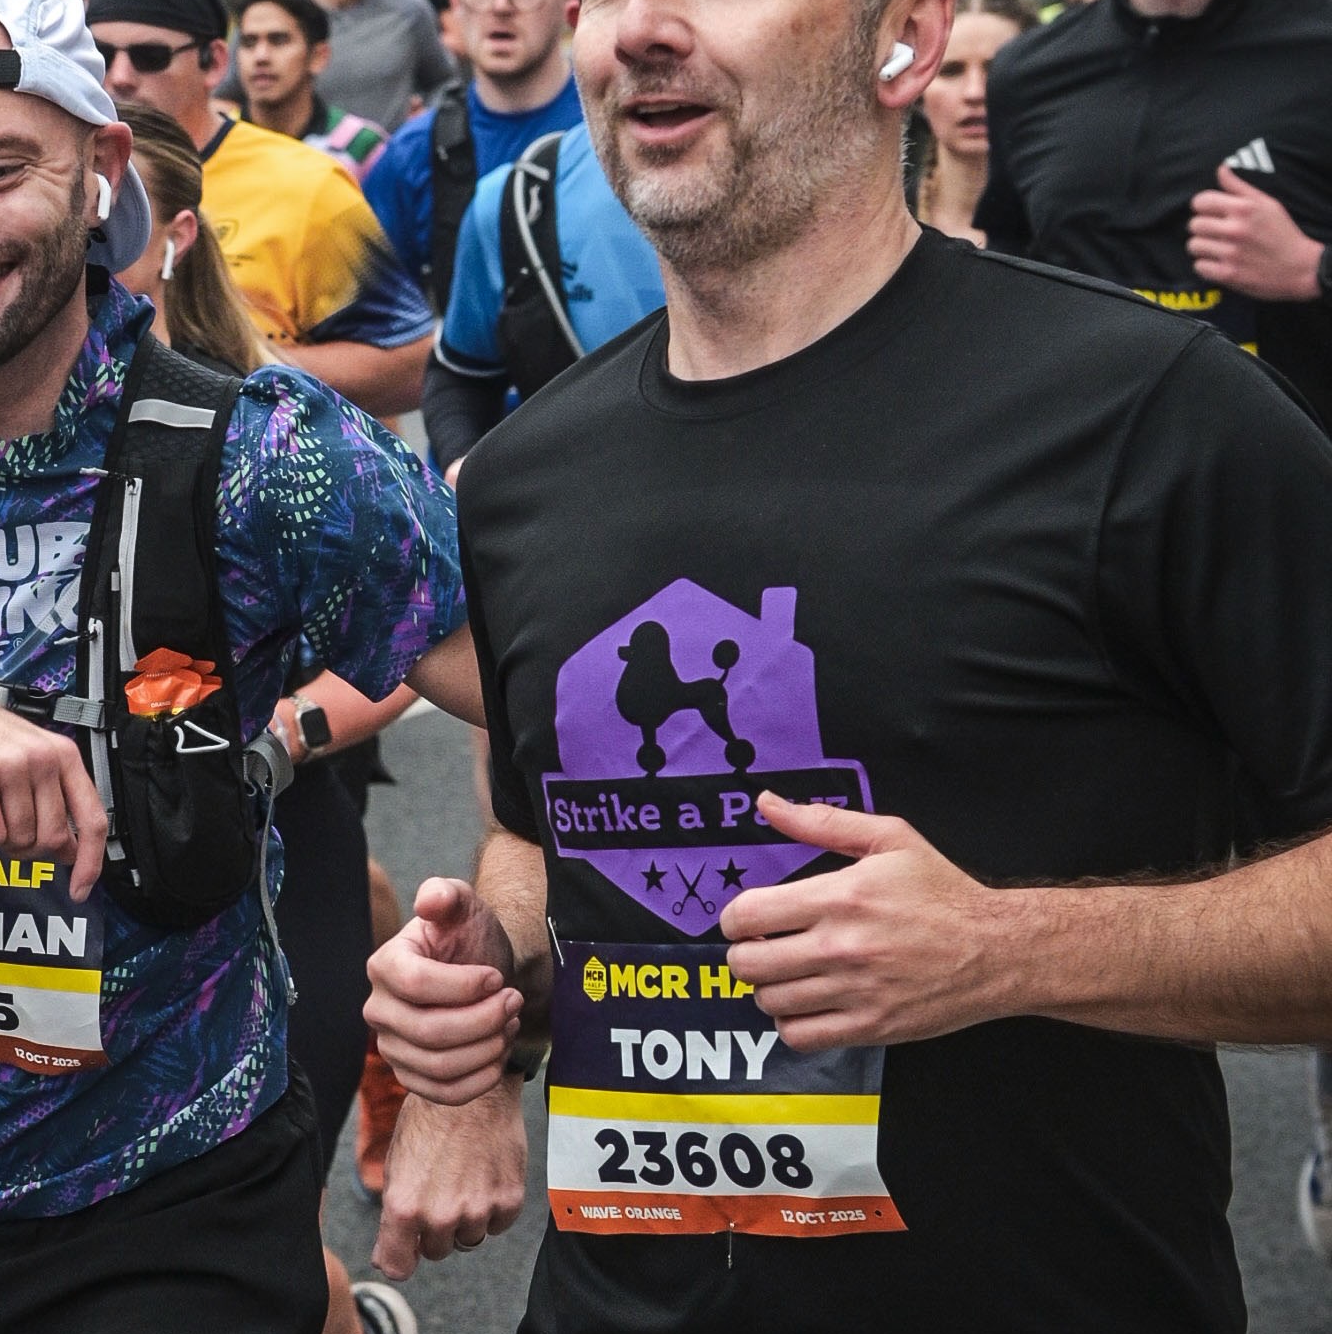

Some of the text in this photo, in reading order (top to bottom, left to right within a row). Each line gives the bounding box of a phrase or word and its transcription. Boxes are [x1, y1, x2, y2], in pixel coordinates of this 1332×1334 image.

[555, 793, 661, 833] Strike
[678, 803, 704, 829] a
[586, 970, 604, 981] MCR
[610, 964, 690, 999] MCR
[51, 1057, 82, 1067] 2025
[610, 1028, 779, 1080] TONY
[594, 1128, 813, 1189] 23608
[580, 1206, 682, 1220] WAVE: ORANGE
[796, 1212, 825, 1224] OCT
[828, 1210, 866, 1222] 2025
